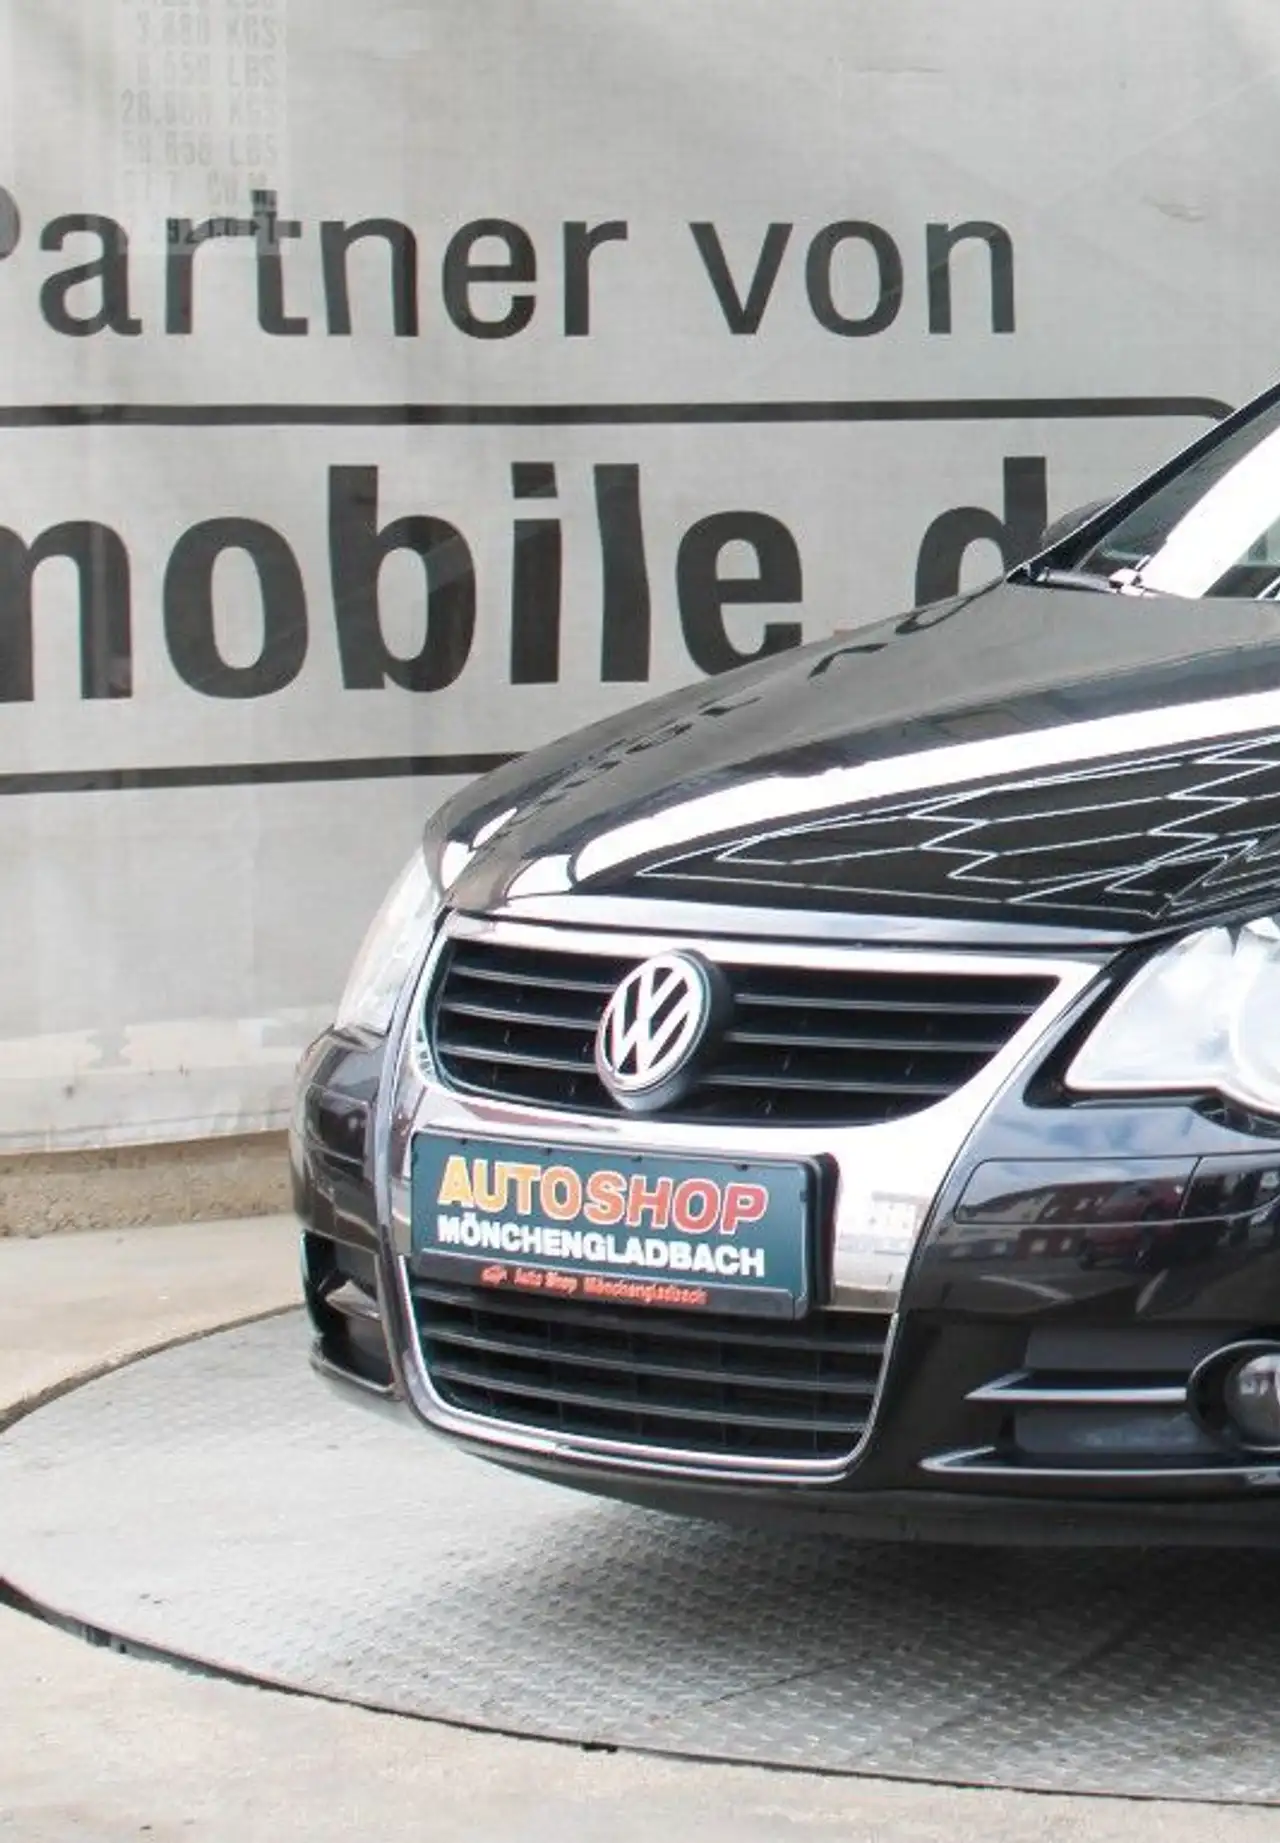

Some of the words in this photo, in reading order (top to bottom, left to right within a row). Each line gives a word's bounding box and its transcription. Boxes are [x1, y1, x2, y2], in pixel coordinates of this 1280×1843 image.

[690, 220, 1017, 337] von
[437, 1155, 768, 1236] AUTOSHOP
[436, 1212, 766, 1279] MÖNCHENGLADBACH
